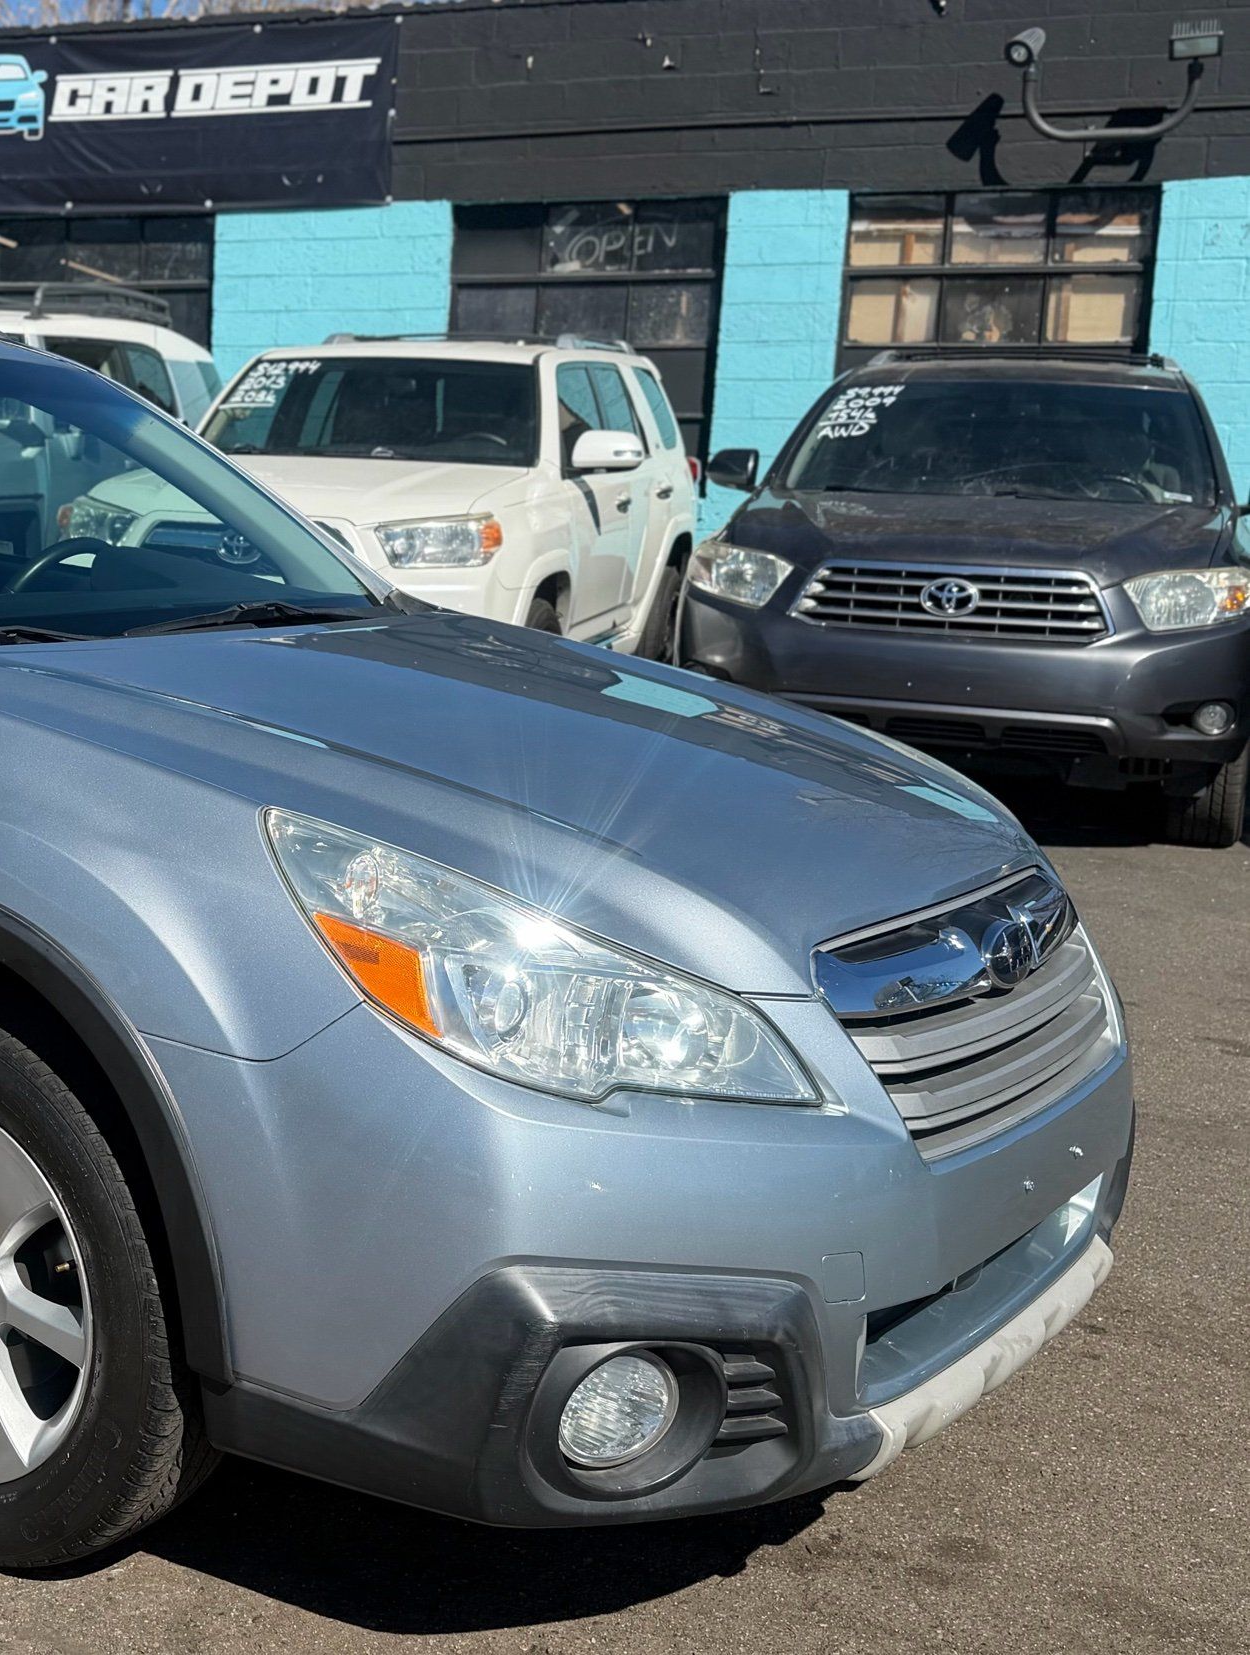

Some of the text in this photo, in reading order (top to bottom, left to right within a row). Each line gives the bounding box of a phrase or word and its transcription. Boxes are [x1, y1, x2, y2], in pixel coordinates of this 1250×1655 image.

[49, 57, 381, 121] CAR DEPOT
[817, 422, 870, 439] AWD
